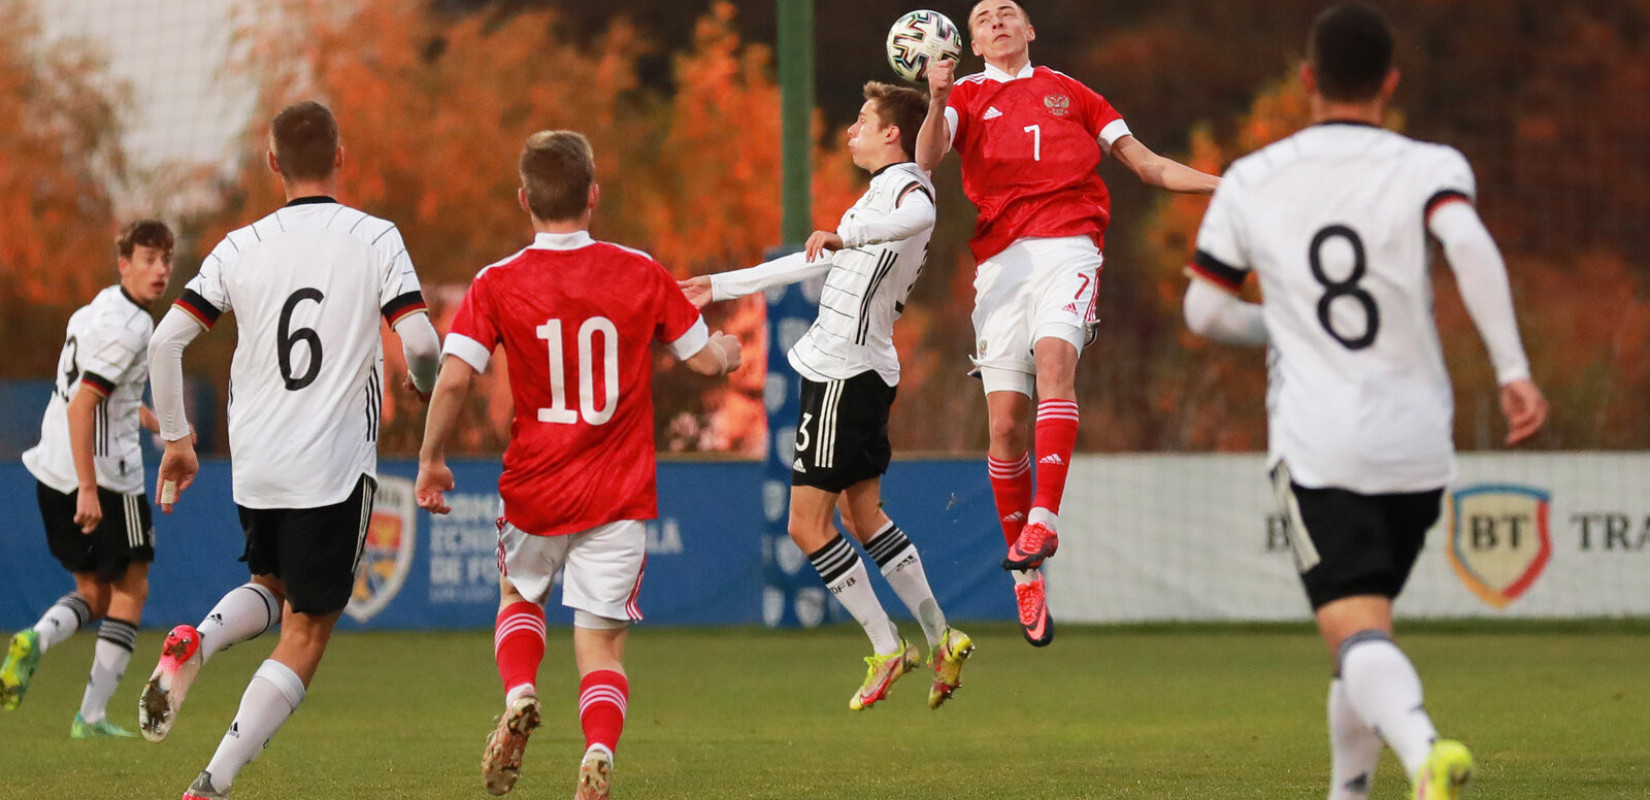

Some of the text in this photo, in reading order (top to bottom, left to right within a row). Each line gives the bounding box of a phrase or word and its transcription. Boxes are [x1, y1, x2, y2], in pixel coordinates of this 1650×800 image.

[1023, 124, 1041, 162] 7
[1074, 272, 1090, 300] 7
[1309, 225, 1380, 351] 8
[277, 287, 324, 391] 6
[536, 316, 619, 425] 10
[1471, 513, 1529, 551] BT
